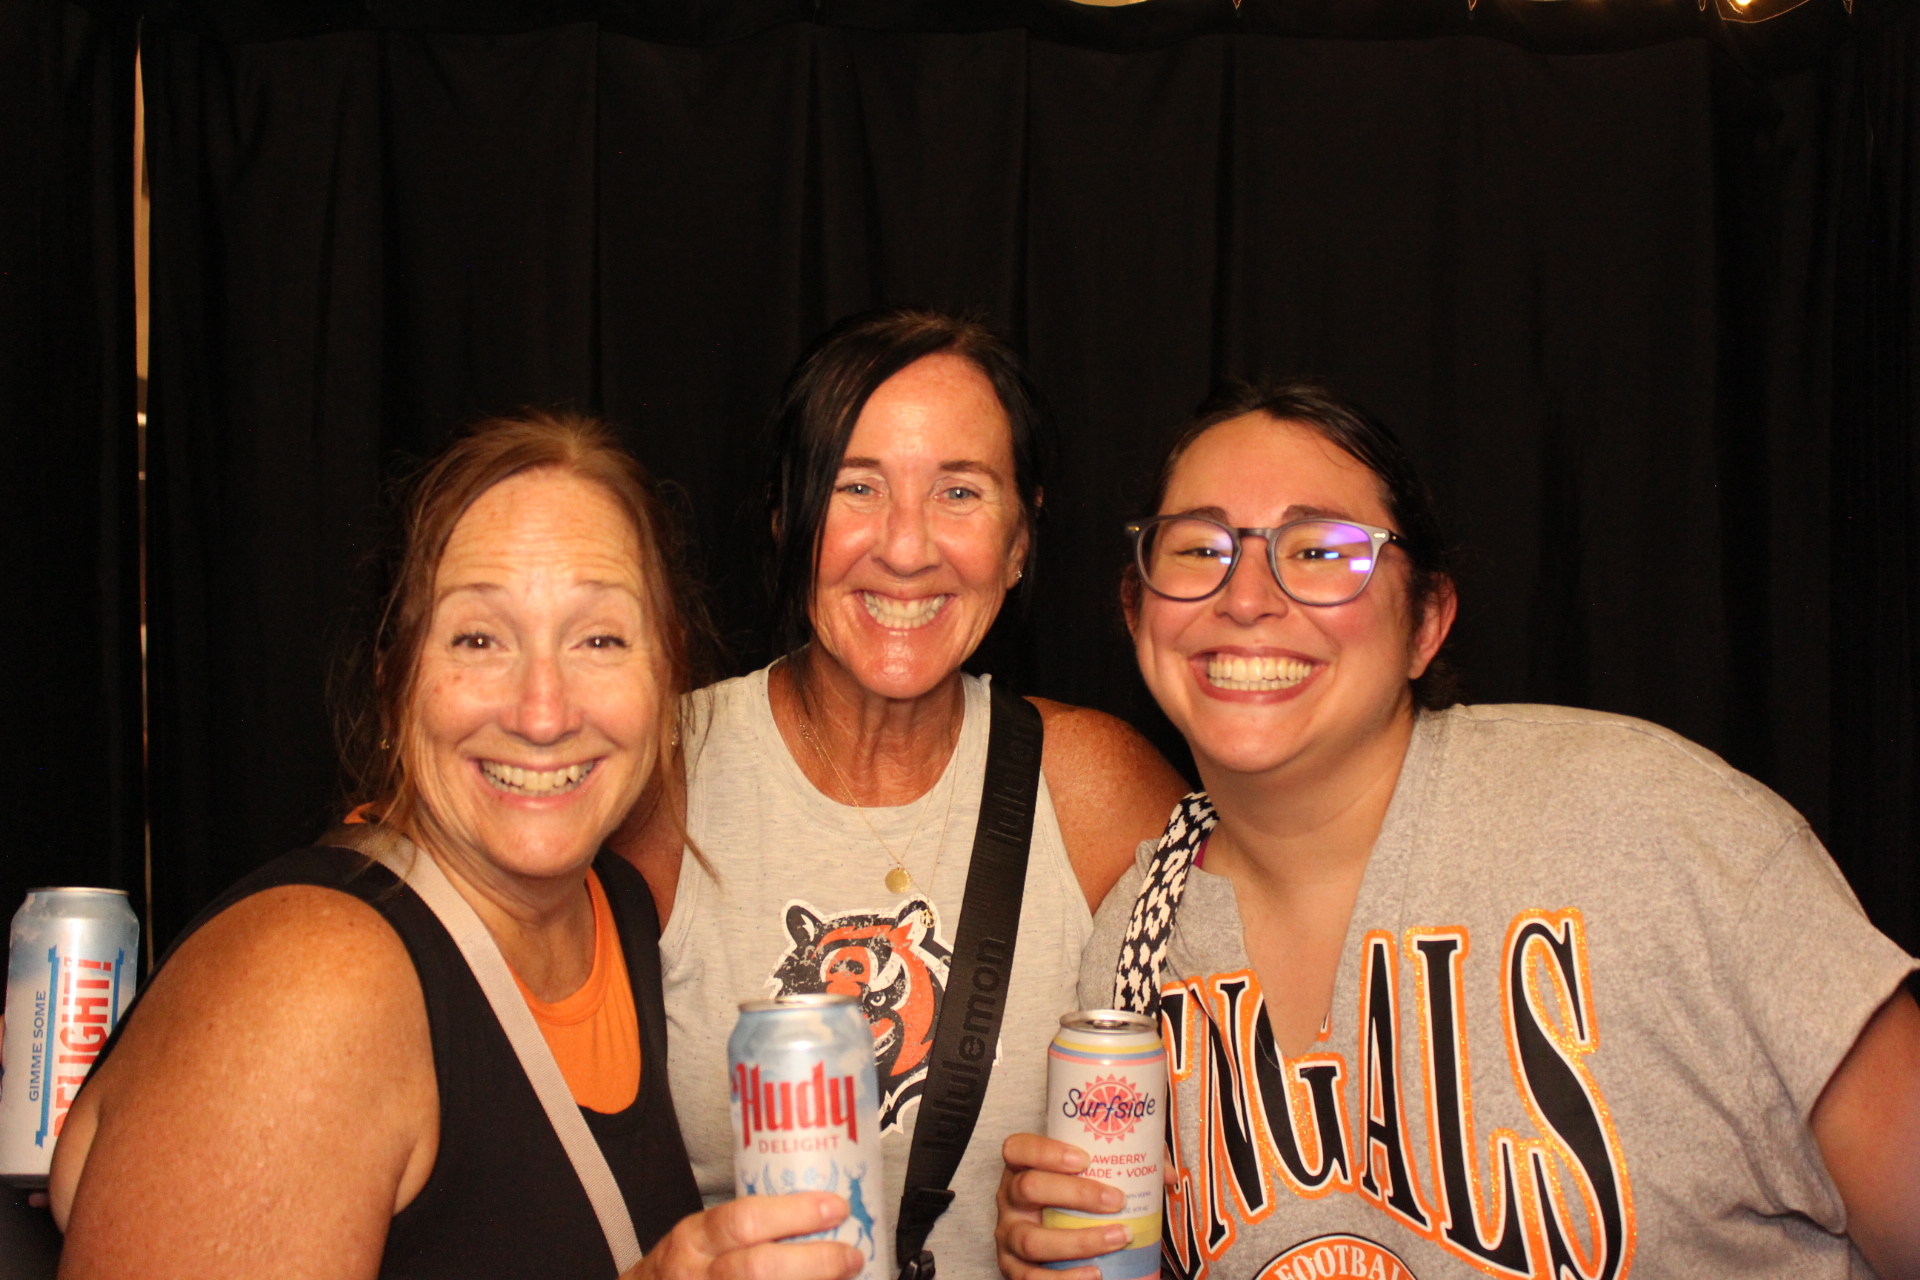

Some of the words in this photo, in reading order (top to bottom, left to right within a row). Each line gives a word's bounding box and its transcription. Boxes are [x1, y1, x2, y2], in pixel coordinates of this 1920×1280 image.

[33, 990, 46, 1039] SOME
[920, 936, 1007, 1150] lululemon
[28, 1042, 43, 1102] GIMME
[1161, 906, 1637, 1280] ENGALS
[732, 1060, 858, 1150] Hudy
[1062, 1087, 1156, 1122] Surfside
[758, 1135, 841, 1155] DELIGHT
[1090, 1152, 1148, 1166] AWBERRY
[1081, 1168, 1113, 1179] NADE
[1125, 1163, 1158, 1179] VODKA
